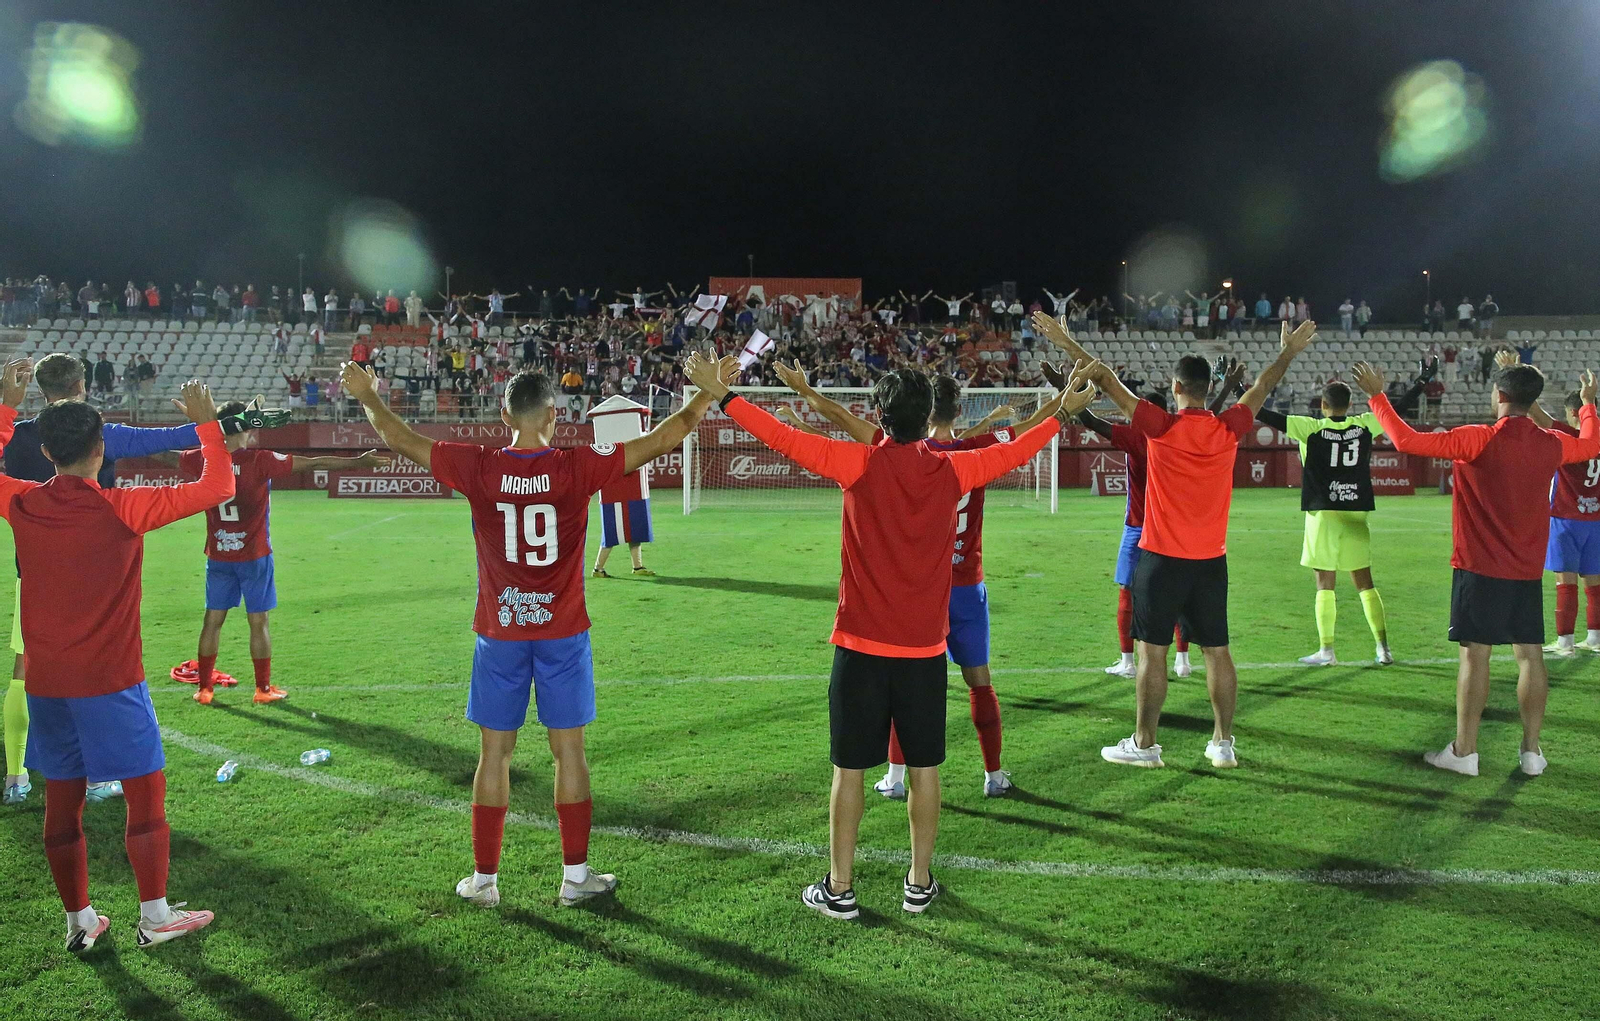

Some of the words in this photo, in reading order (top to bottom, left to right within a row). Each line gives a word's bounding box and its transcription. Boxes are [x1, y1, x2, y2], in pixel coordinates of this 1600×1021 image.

[355, 432, 386, 445] Troc
[1330, 438, 1360, 467] 13
[500, 473, 550, 495] MARINO
[496, 502, 559, 566] 19
[498, 586, 555, 611] Algeciras
[515, 605, 553, 625] Gusta
